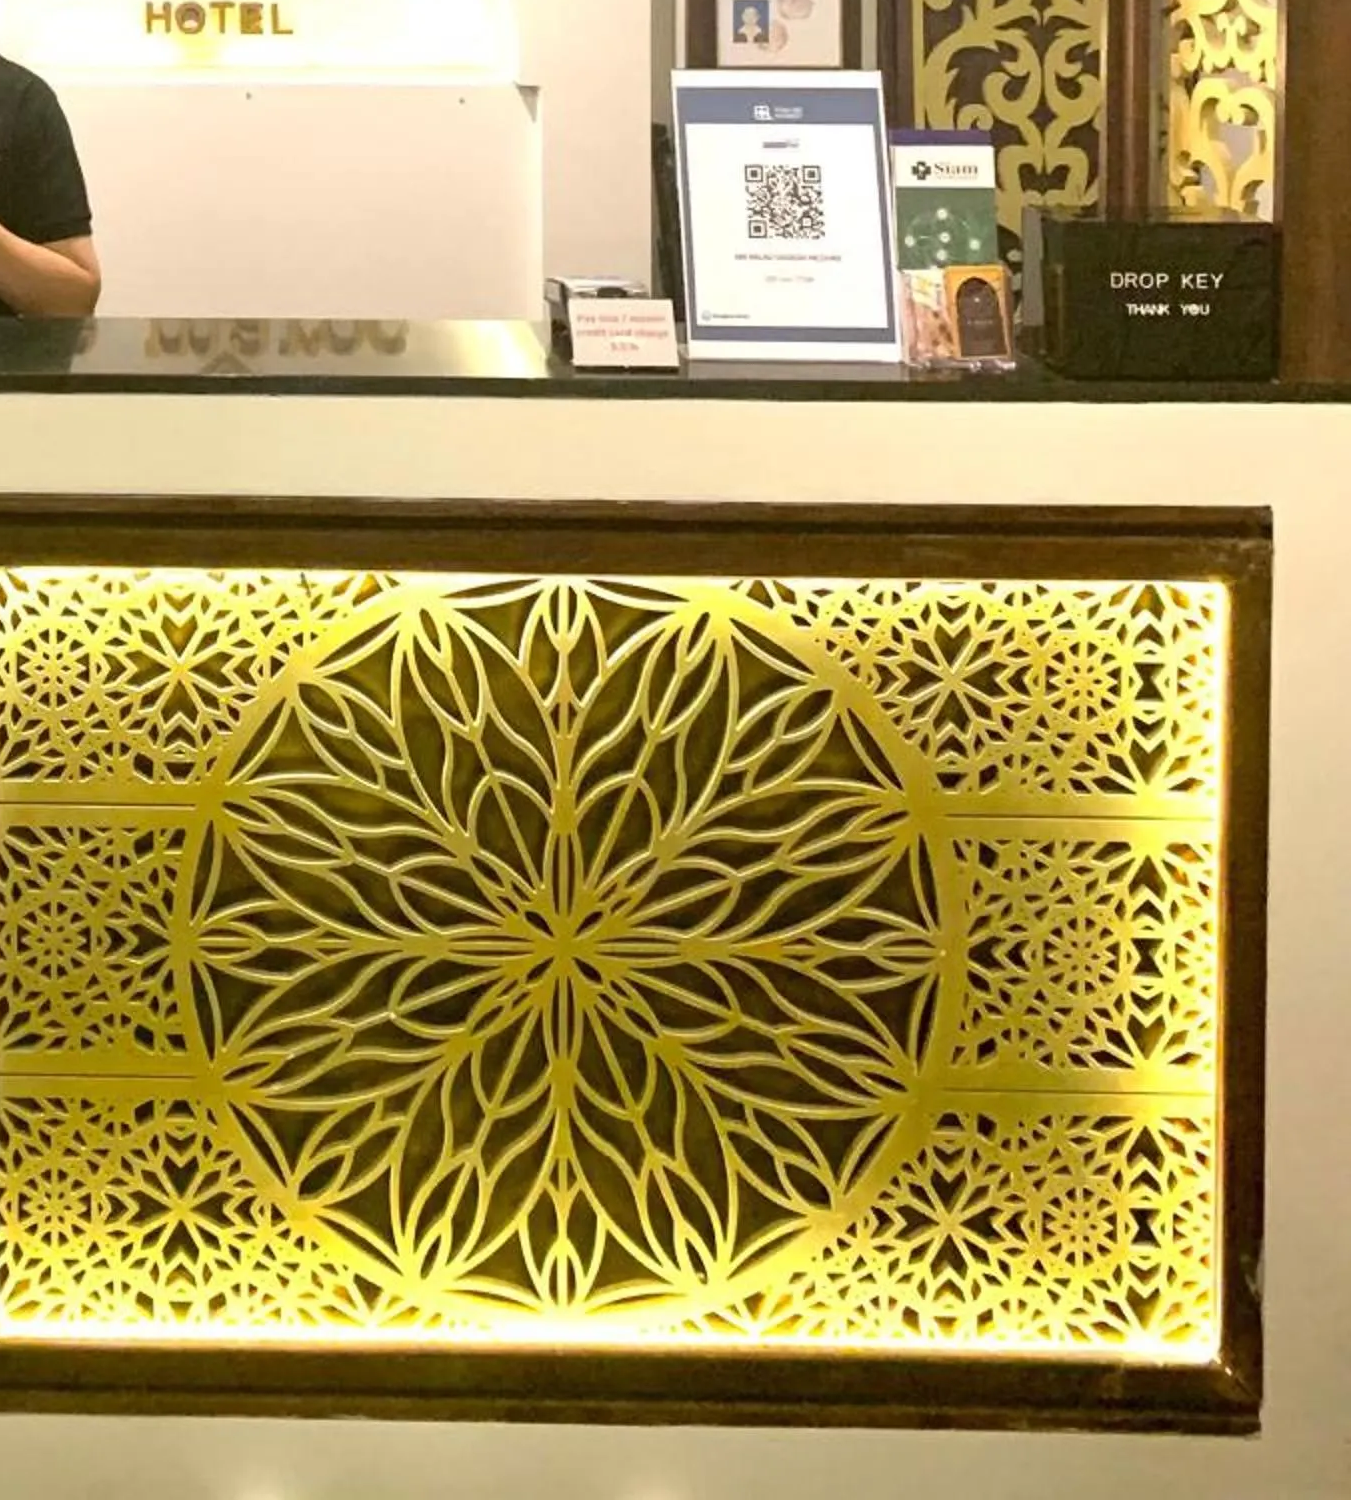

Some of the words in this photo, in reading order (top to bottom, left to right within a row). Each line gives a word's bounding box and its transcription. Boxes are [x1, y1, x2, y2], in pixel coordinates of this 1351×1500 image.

[145, 1, 294, 35] HOTEL
[1110, 272, 1169, 289] DROP
[1180, 273, 1224, 289] KEY
[1126, 303, 1170, 316] THANK
[1180, 303, 1210, 316] YOU
